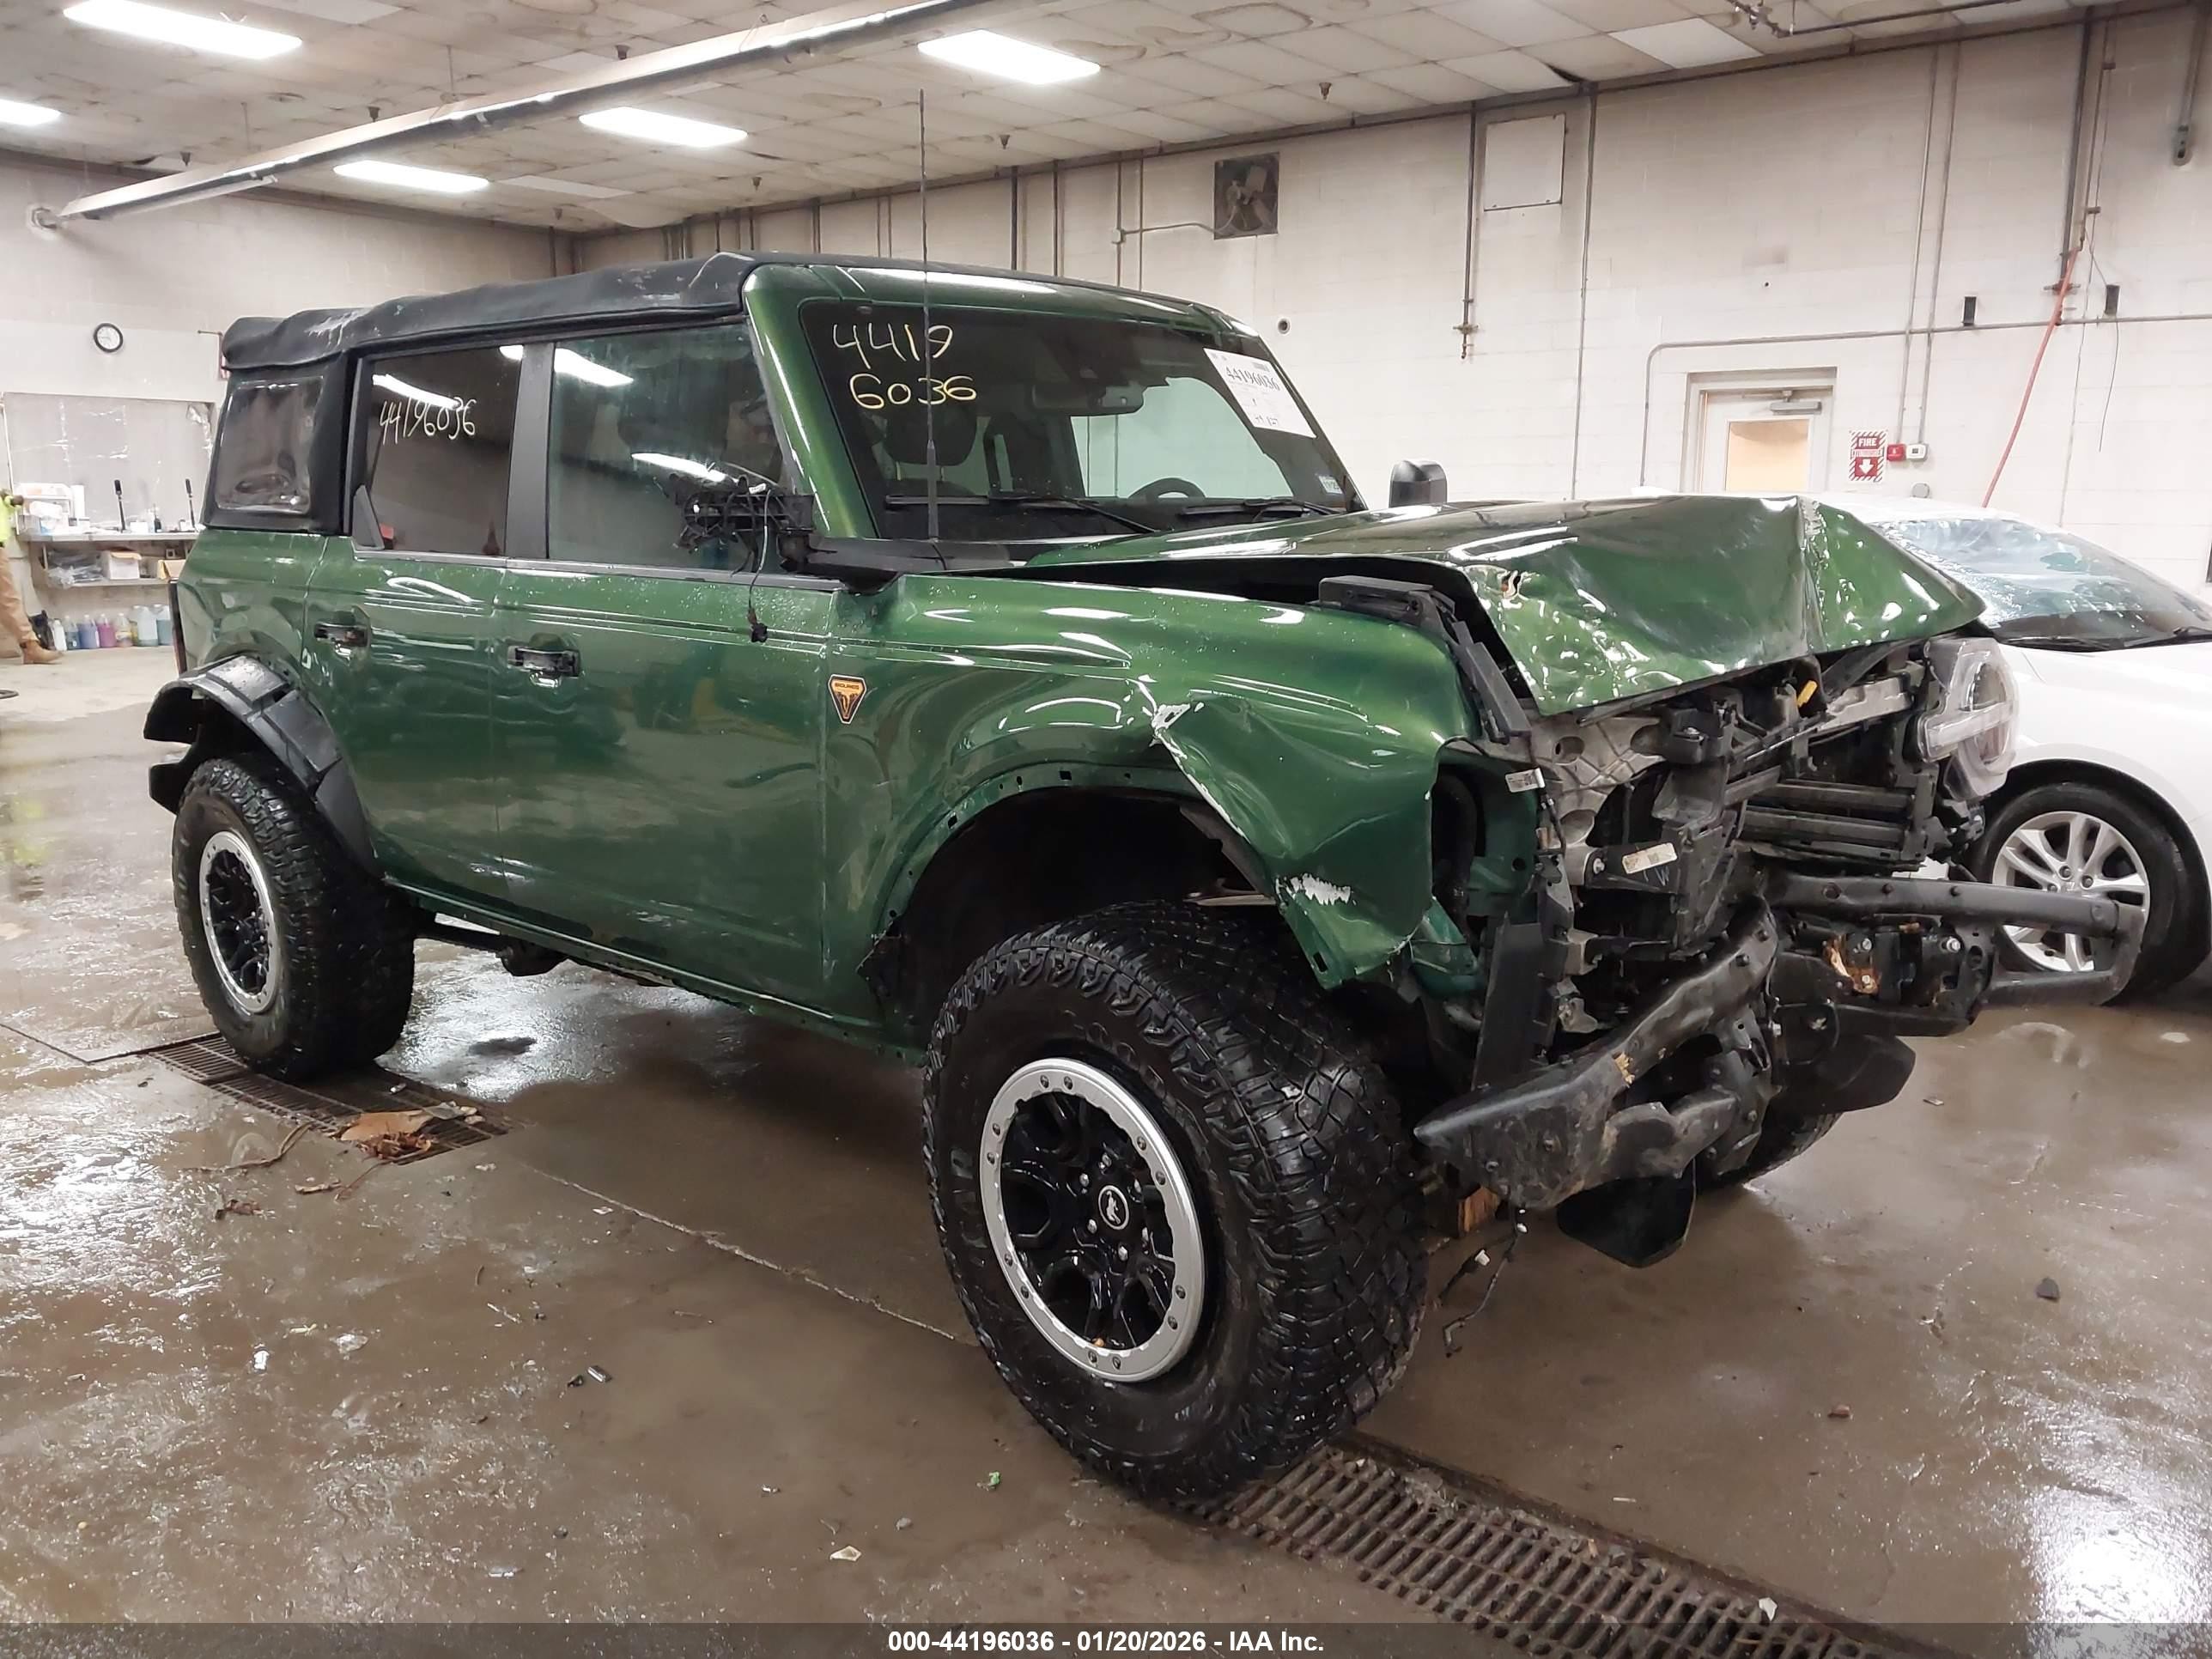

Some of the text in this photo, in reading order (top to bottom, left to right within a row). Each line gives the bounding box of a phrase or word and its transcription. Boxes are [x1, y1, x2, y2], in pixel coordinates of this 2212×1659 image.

[833, 323, 953, 369] 4419
[849, 374, 977, 410] 6036
[1225, 367, 1280, 391] 44196036
[1858, 437, 1877, 447] FIRE
